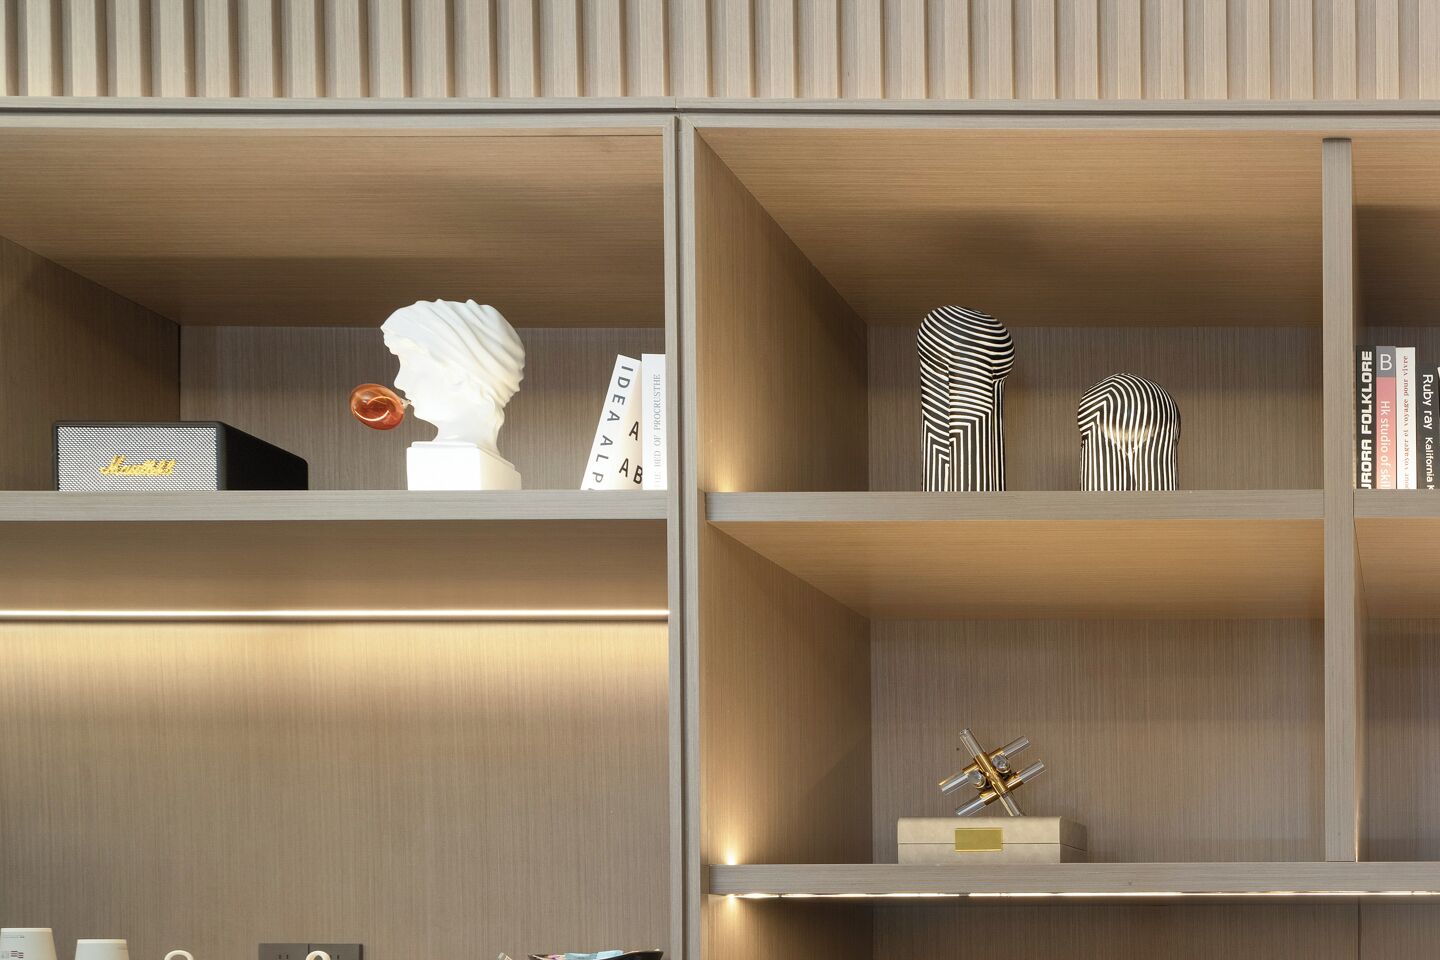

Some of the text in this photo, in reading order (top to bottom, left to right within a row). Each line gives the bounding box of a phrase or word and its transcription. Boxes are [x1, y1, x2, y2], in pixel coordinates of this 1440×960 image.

[1380, 353, 1393, 371] B
[653, 373, 661, 430] PROCRUSTHE
[1361, 350, 1373, 435] FOLKLORE
[1422, 374, 1434, 406] Ruby
[1380, 401, 1391, 416] Hk
[1423, 410, 1433, 430] ray
[587, 365, 634, 490] IDEA ALP
[629, 421, 640, 441] A
[1380, 418, 1391, 453] studio
[653, 435, 661, 447] OF
[1380, 455, 1392, 469] of
[1424, 437, 1435, 483] Kalifornia
